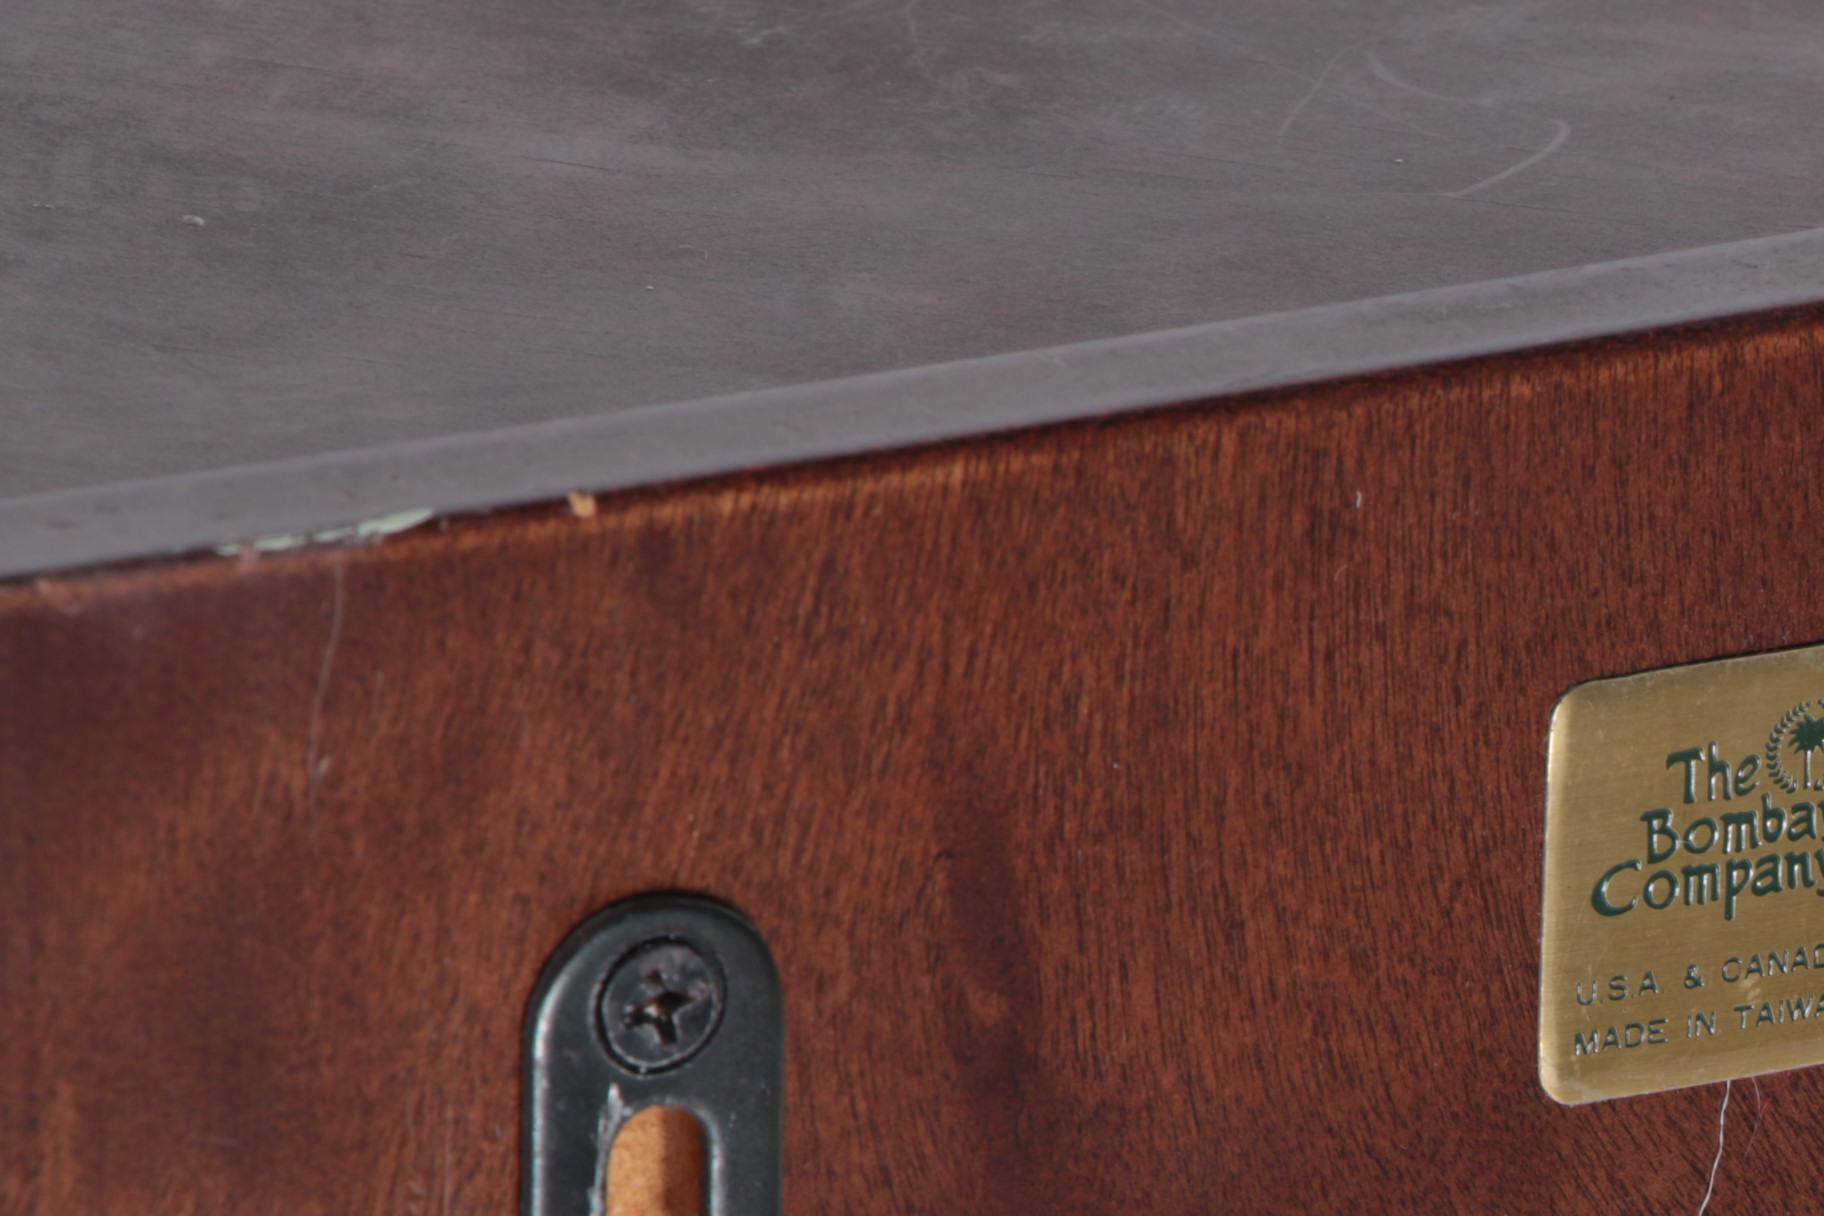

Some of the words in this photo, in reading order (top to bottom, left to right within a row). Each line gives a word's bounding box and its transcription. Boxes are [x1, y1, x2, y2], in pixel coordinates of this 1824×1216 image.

[1665, 741, 1762, 804] The
[1683, 964, 1705, 990] &
[1574, 1018, 1670, 1057] MADE
[1686, 1010, 1717, 1038] IN
